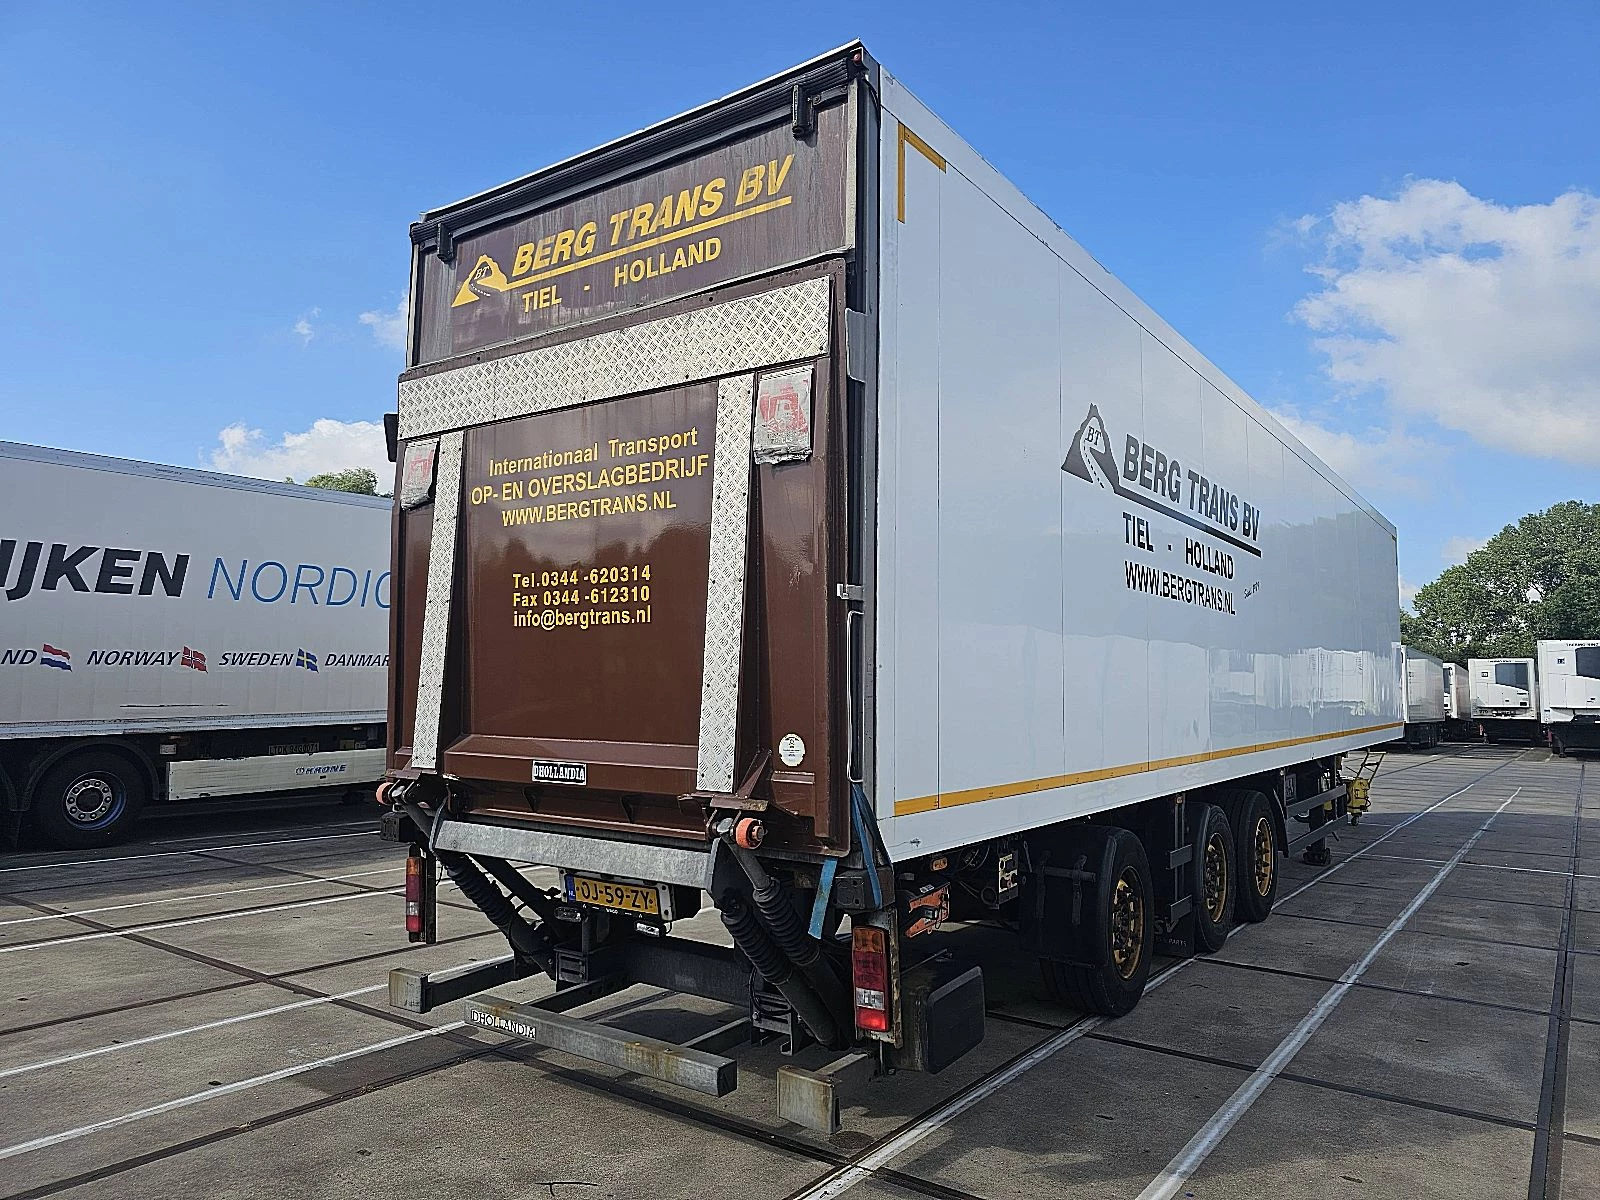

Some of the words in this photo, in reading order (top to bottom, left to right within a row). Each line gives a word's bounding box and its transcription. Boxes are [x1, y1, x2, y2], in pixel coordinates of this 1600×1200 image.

[511, 221, 597, 277] BERG
[609, 177, 726, 246] TRANS
[734, 154, 795, 207] BV
[473, 265, 490, 280] BT
[522, 285, 562, 313] TIEL
[614, 237, 722, 288] HOLLAND
[1085, 426, 1101, 446] BT
[489, 443, 598, 477] Internationaal
[608, 427, 698, 458] Transport
[471, 485, 499, 505] OP-
[502, 480, 523, 501] EN
[527, 455, 709, 497] OVERSLAGBEDRIJF
[1123, 433, 1181, 504] BERG
[1188, 469, 1239, 532] TRANS
[1242, 502, 1260, 542] BV
[502, 490, 677, 527] WWW.BERGTRANS.NL
[1122, 511, 1154, 552] TIEL
[1185, 537, 1234, 580] HOLLAND
[513, 570, 579, 588] Tel.0344
[583, 565, 651, 584] -620314
[1124, 560, 1236, 616] WWW.BERGTRANS.NL
[513, 592, 538, 607] Fax
[543, 590, 580, 606] 0344
[584, 586, 650, 604] -612310
[513, 604, 651, 631] info@bergtrans.nl
[86, 650, 180, 666] NORWAY
[218, 652, 294, 666] SWEDEN
[305, 764, 347, 775] KRONE
[533, 765, 585, 781] DHOLLANDIA
[471, 1009, 537, 1040] DHOLLANDIA
